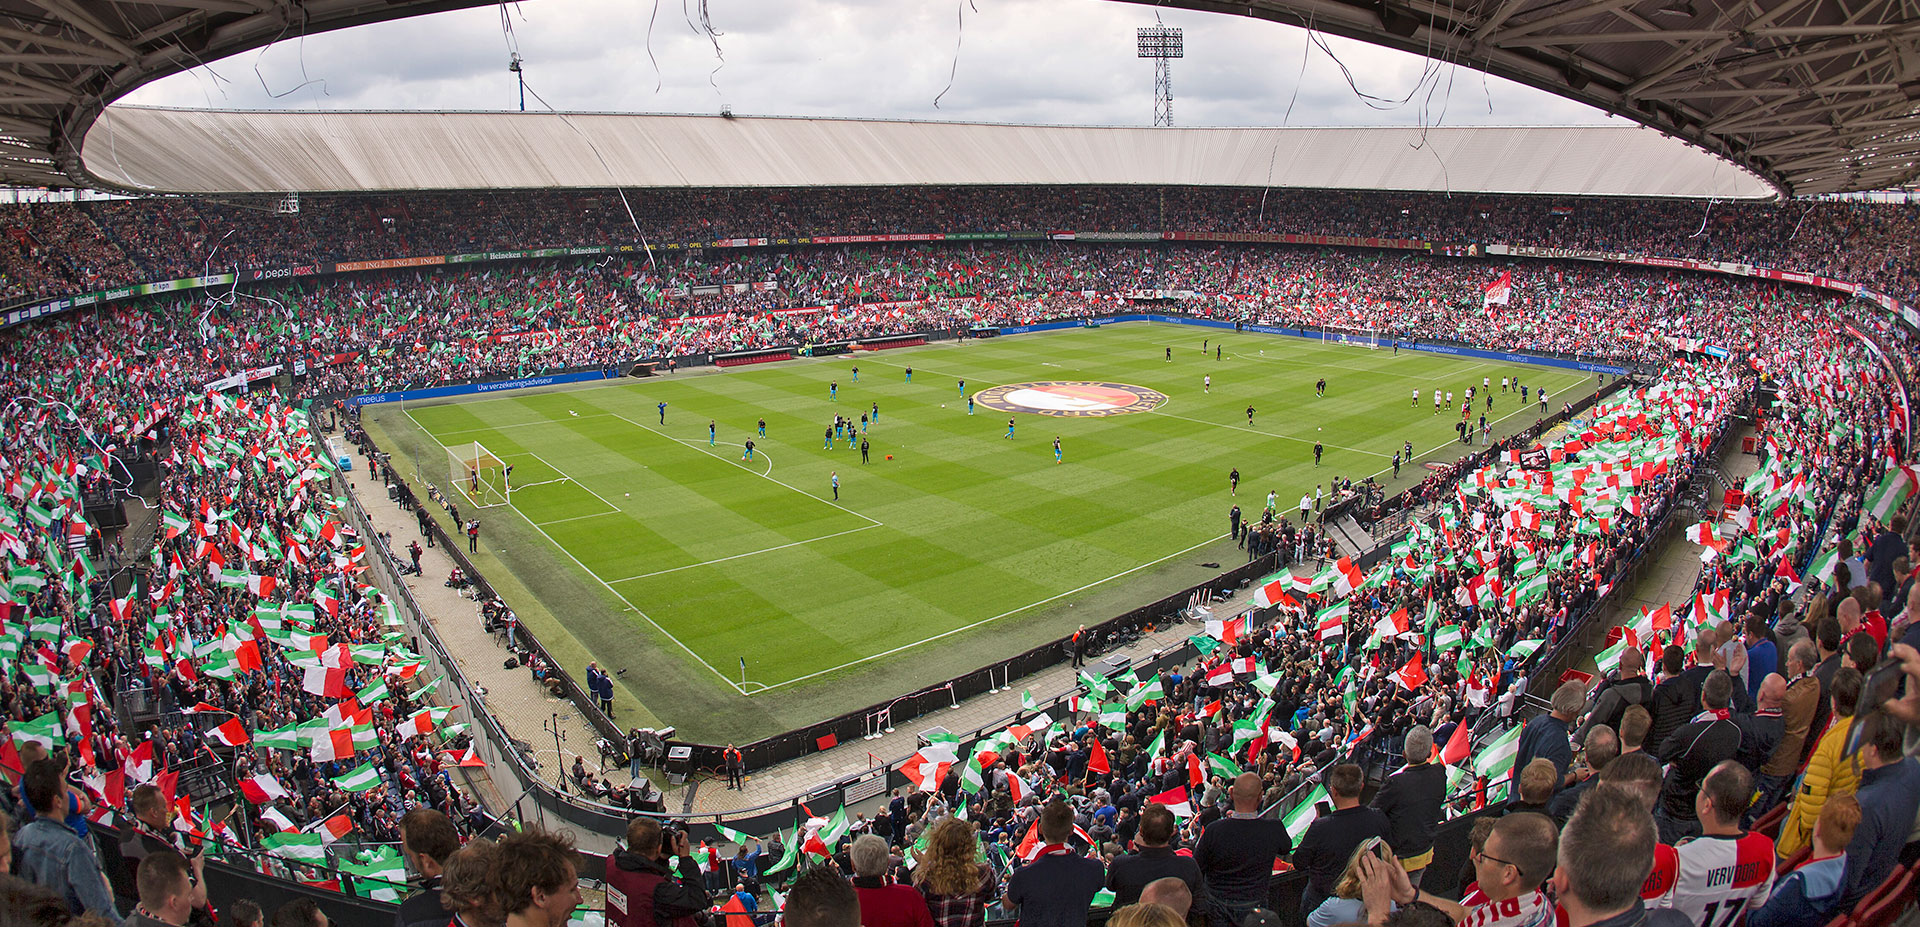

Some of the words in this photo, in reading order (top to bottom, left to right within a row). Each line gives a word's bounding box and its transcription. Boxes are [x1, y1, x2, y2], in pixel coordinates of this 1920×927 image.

[1296, 234, 1321, 244] DAT
[1326, 235, 1354, 246] BEN
[1378, 238, 1398, 249] EN
[1403, 239, 1424, 250] JIJ
[490, 251, 521, 260] Heineken
[571, 247, 600, 255] Heineken
[420, 257, 435, 265] ING
[265, 267, 292, 279] pepsi
[292, 265, 315, 277] MAX
[337, 264, 353, 272] ING
[207, 276, 219, 285] kpn
[158, 282, 170, 291] kpn
[1506, 355, 1529, 363] meeus
[489, 378, 553, 390] verzekeringsadviseur
[356, 394, 386, 405] meeus
[1701, 897, 1747, 927] 17
